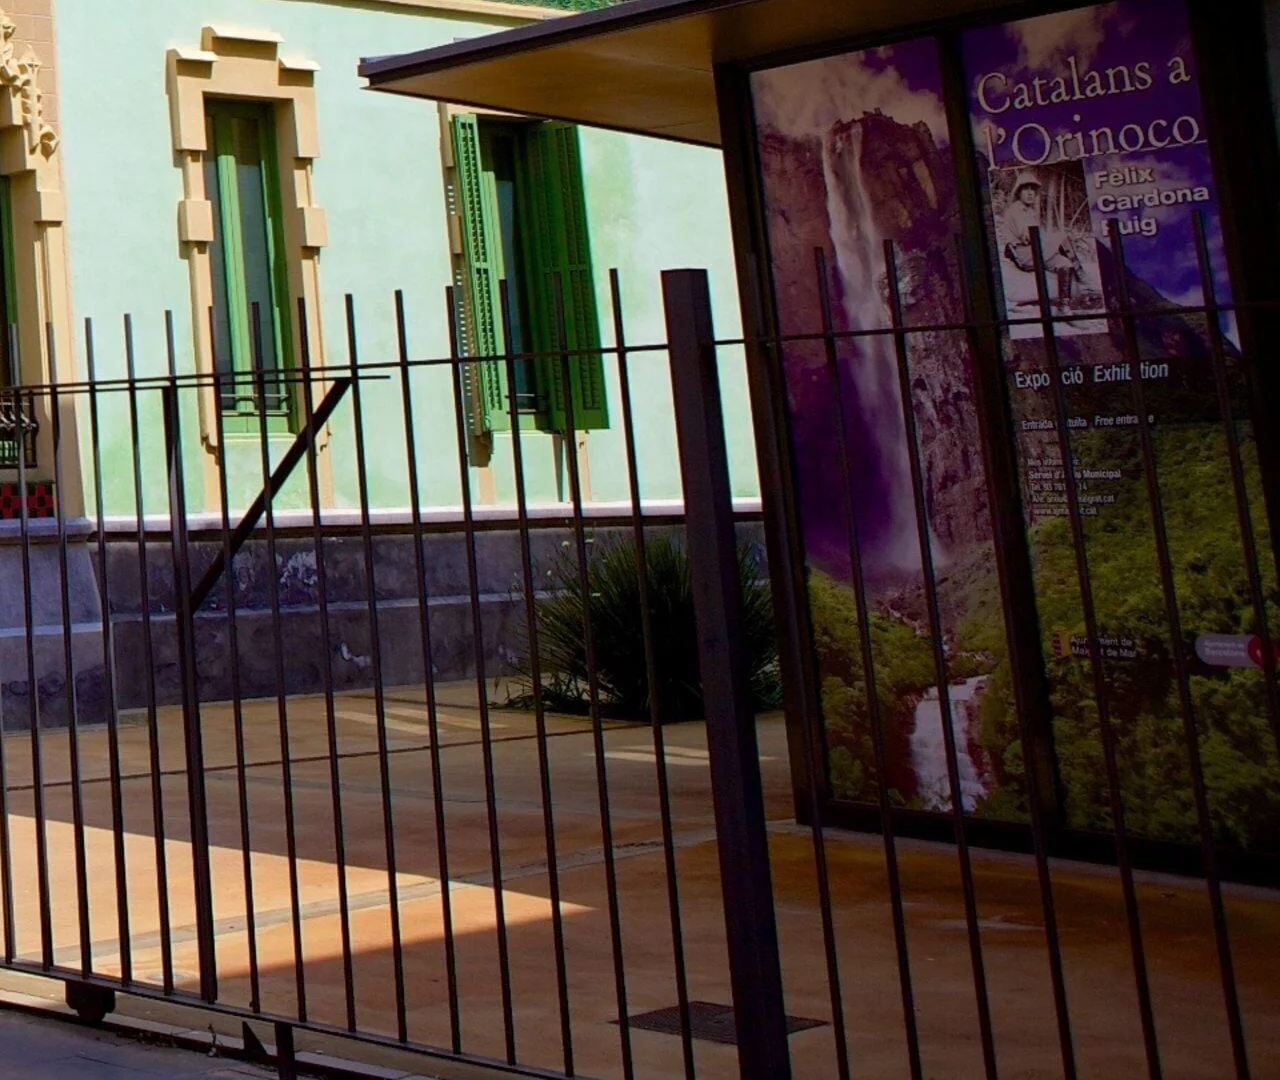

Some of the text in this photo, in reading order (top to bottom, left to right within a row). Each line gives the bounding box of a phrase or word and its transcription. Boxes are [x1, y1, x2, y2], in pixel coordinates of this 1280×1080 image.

[976, 56, 1191, 114] Catalans a
[983, 114, 1200, 170] l'Orinoco
[1094, 166, 1155, 189] Fèlix
[1096, 185, 1210, 212] Cardona
[1015, 360, 1169, 390] Expoció Exhibtion
[1115, 414, 1155, 426] entrae
[1083, 469, 1122, 481] Municipal
[1070, 635, 1119, 646] Ajunment
[1071, 646, 1105, 657] Malgt
